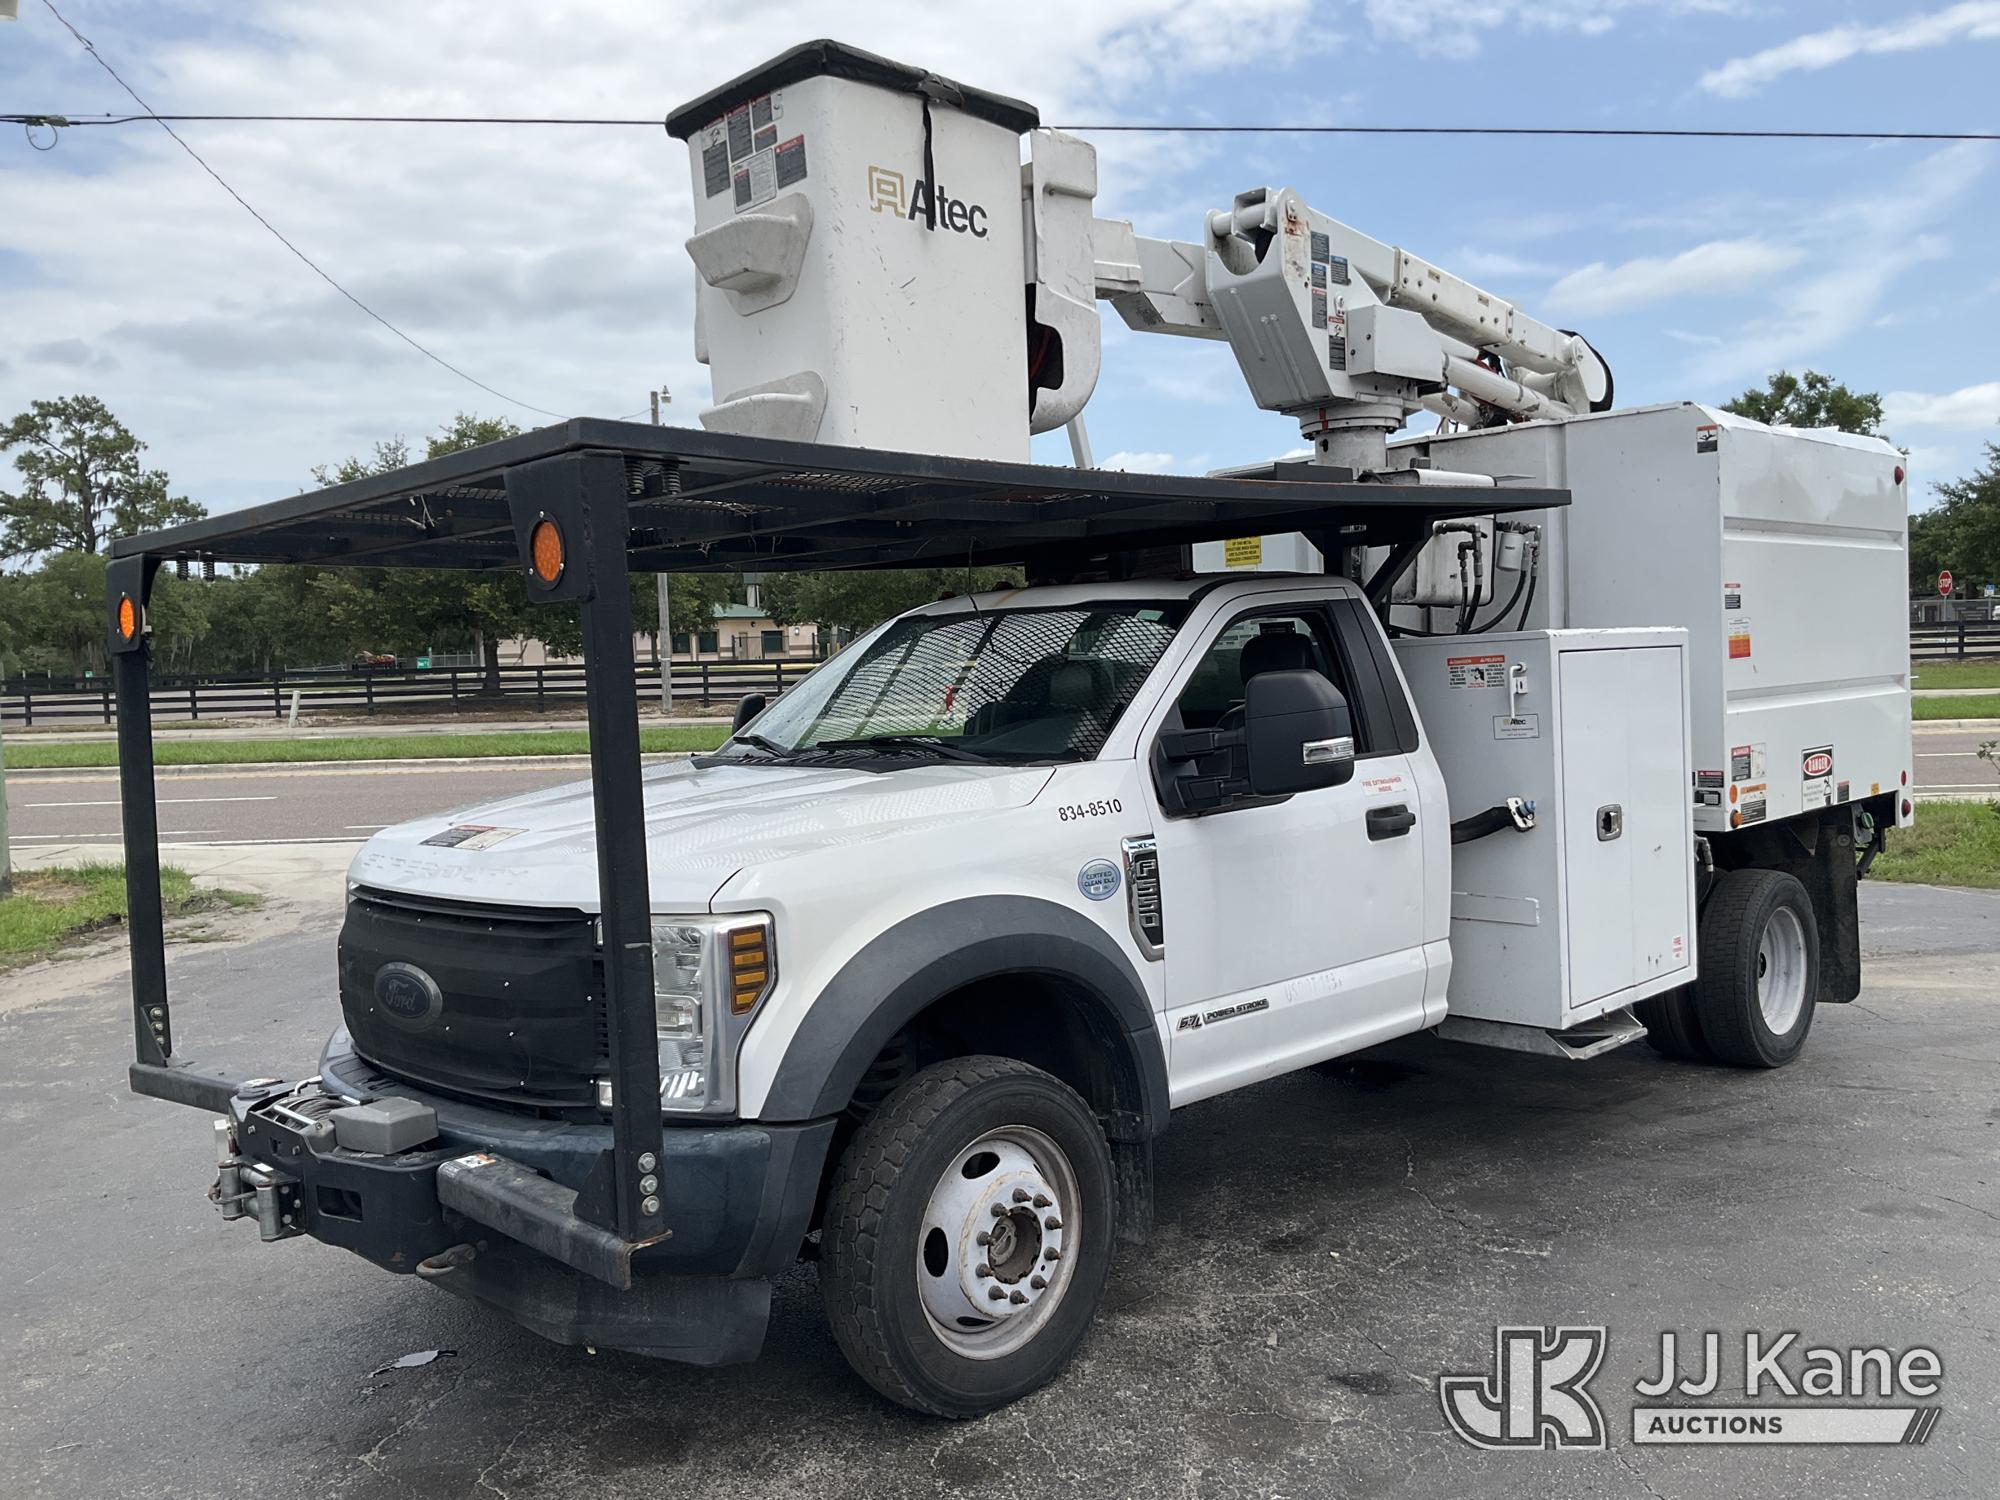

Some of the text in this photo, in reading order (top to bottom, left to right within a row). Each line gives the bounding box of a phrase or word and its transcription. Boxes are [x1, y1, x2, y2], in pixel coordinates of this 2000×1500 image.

[907, 179, 988, 239] Atec
[1940, 578, 1951, 588] STOP
[1808, 756, 1828, 772] DANGER
[1058, 798, 1122, 822] 834-8510
[1084, 876, 1115, 887] CLEAN IDLE
[1086, 870, 1113, 880] CERTIFIED
[385, 978, 416, 1011] Ford
[1206, 1006, 1235, 1020] POWER
[1236, 998, 1268, 1013] STROKE
